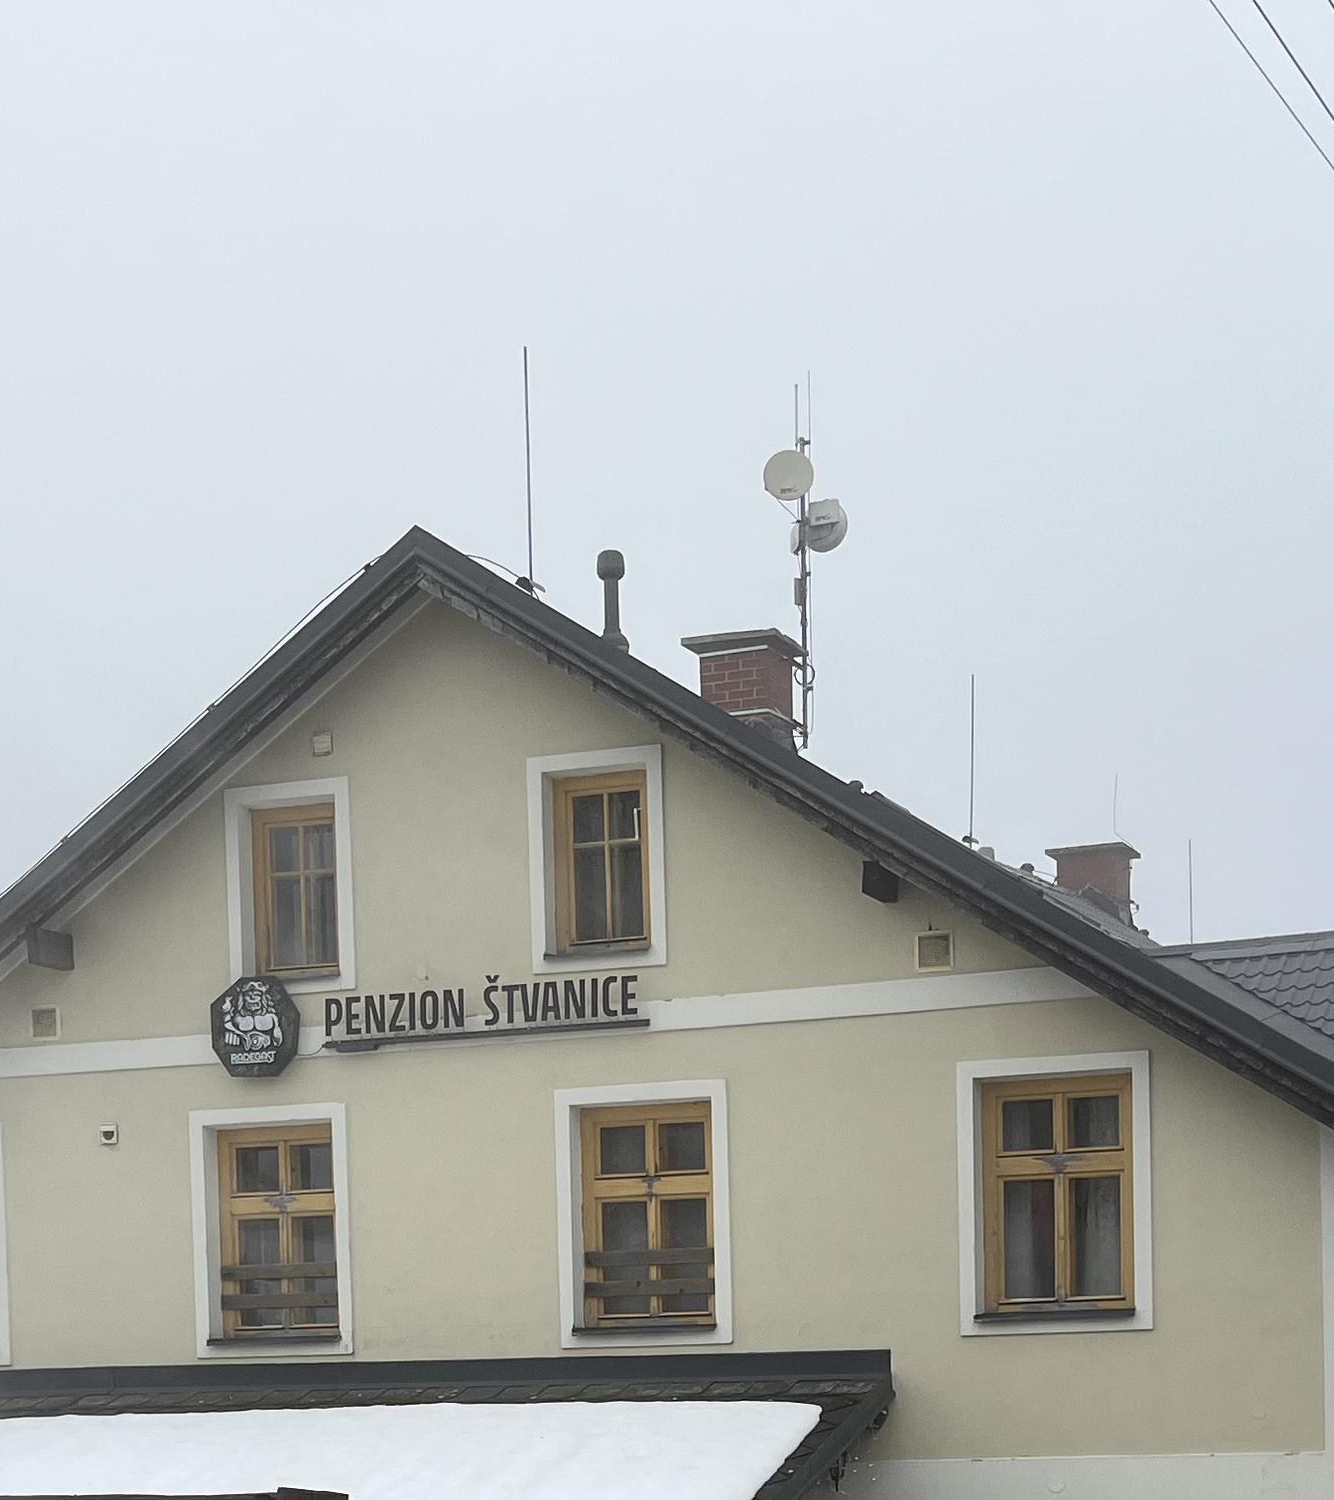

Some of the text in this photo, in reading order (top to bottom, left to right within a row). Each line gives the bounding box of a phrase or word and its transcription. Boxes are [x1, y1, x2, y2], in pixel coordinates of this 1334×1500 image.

[324, 975, 638, 1037] PENZION ŠTVANICE
[230, 1051, 277, 1065] RADEGAST
